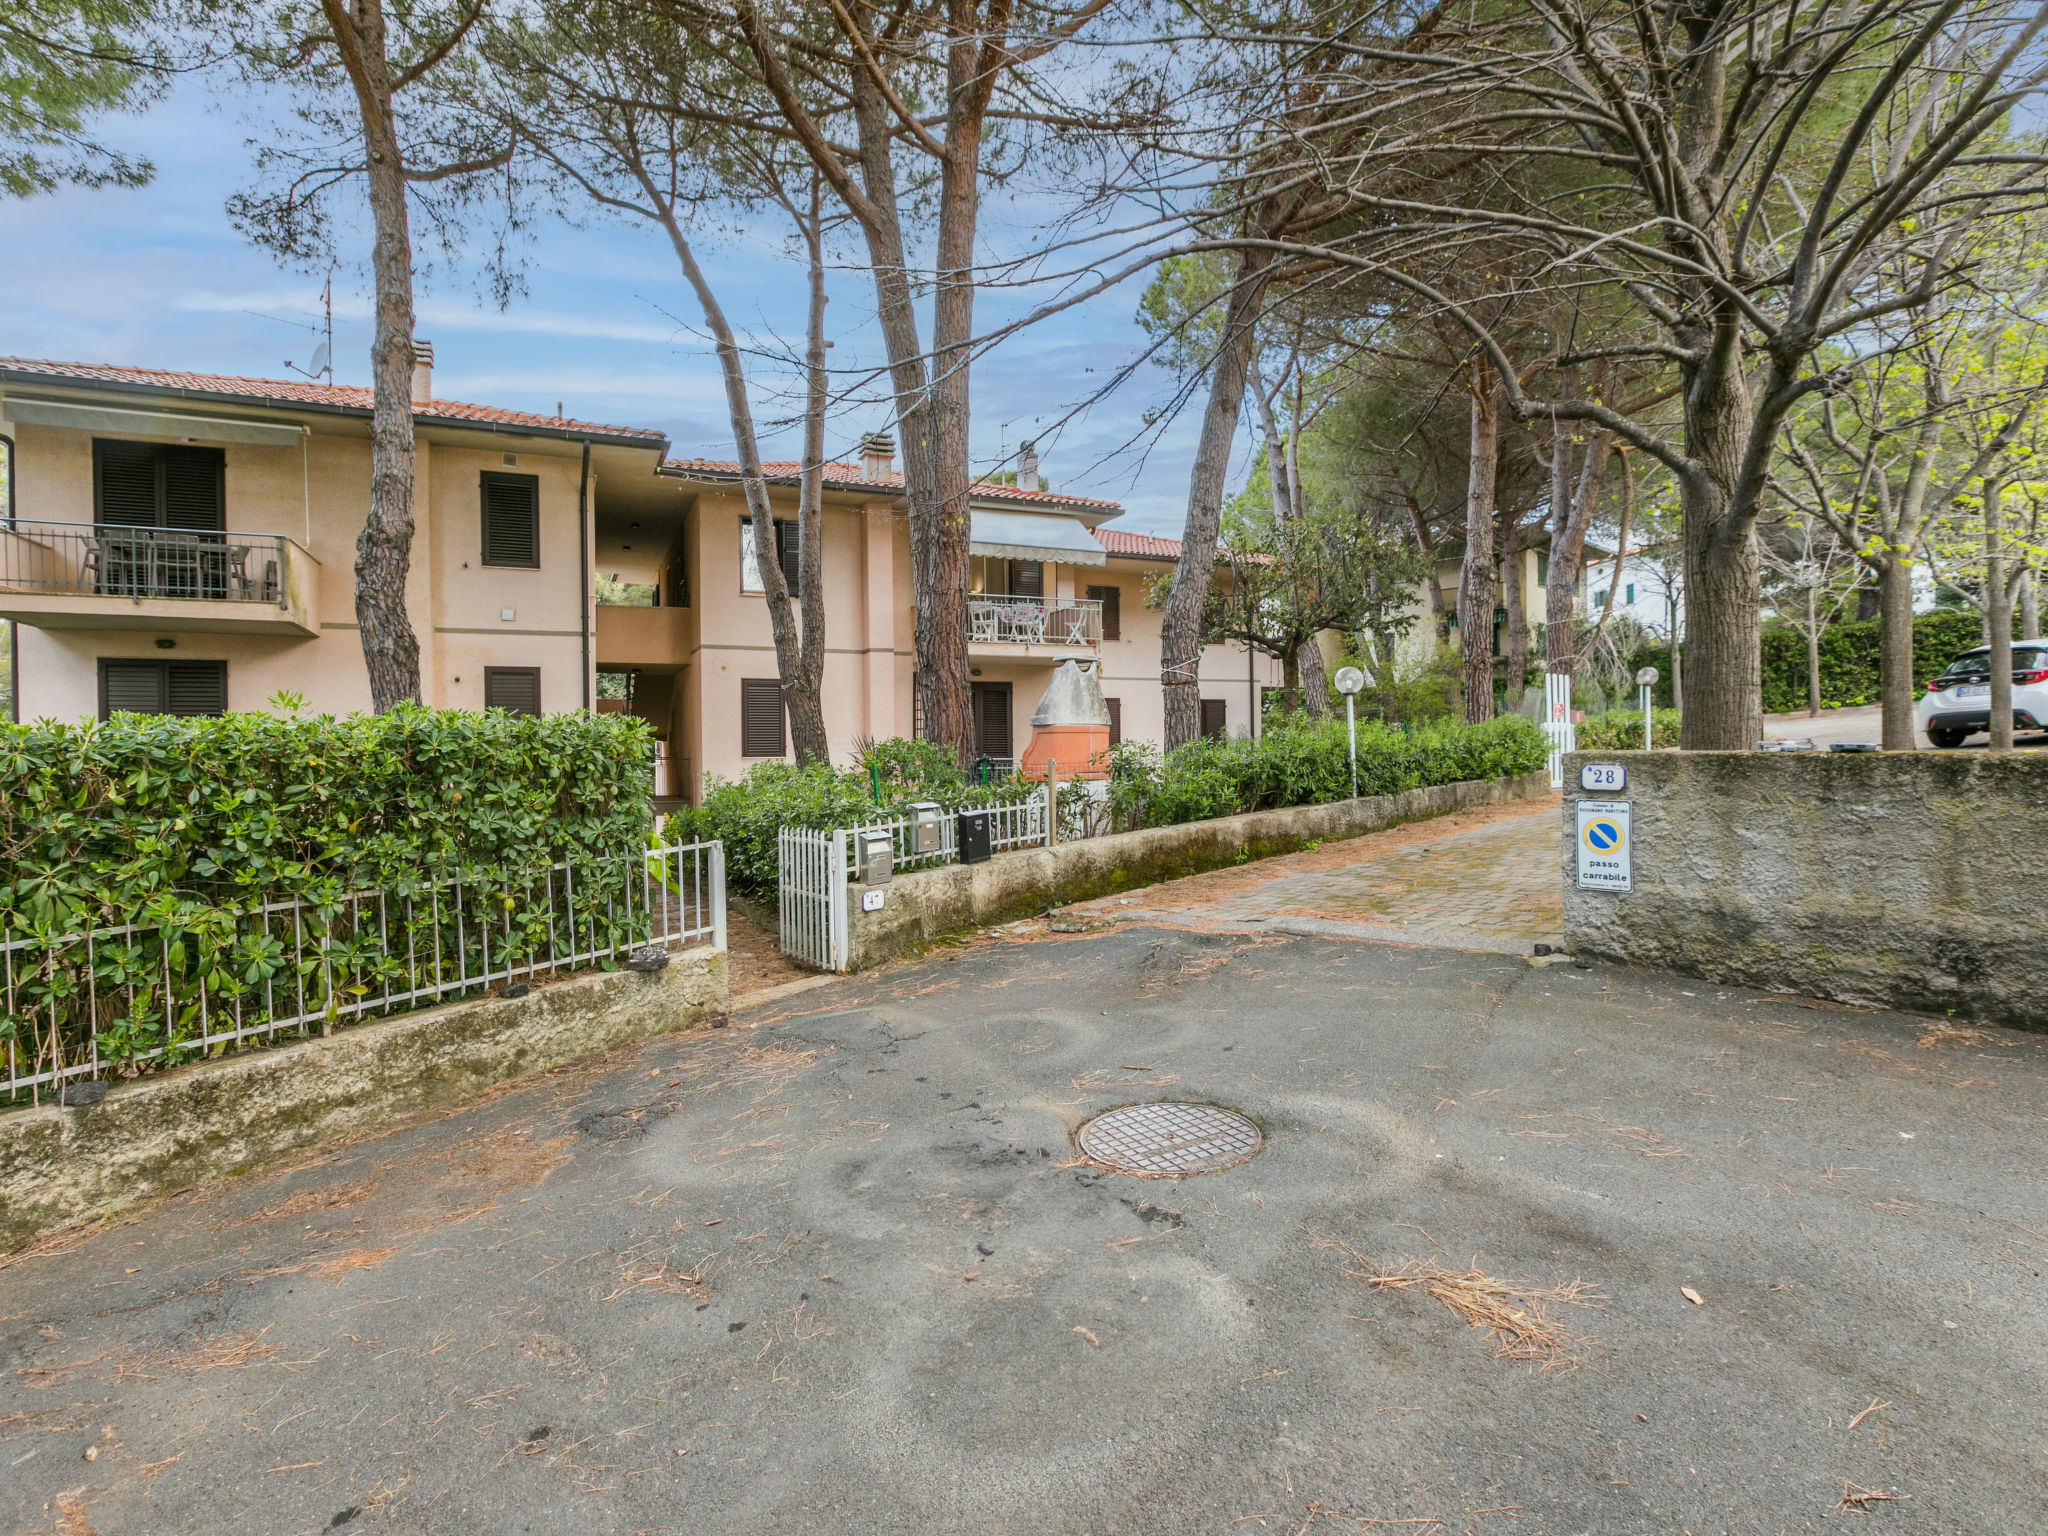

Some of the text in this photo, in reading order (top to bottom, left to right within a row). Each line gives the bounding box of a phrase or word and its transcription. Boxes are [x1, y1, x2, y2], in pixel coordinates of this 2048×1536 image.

[1594, 769, 1615, 784] 28
[1589, 860, 1620, 869] passo
[1582, 872, 1627, 882] carrabile
[869, 894, 879, 905] 47
